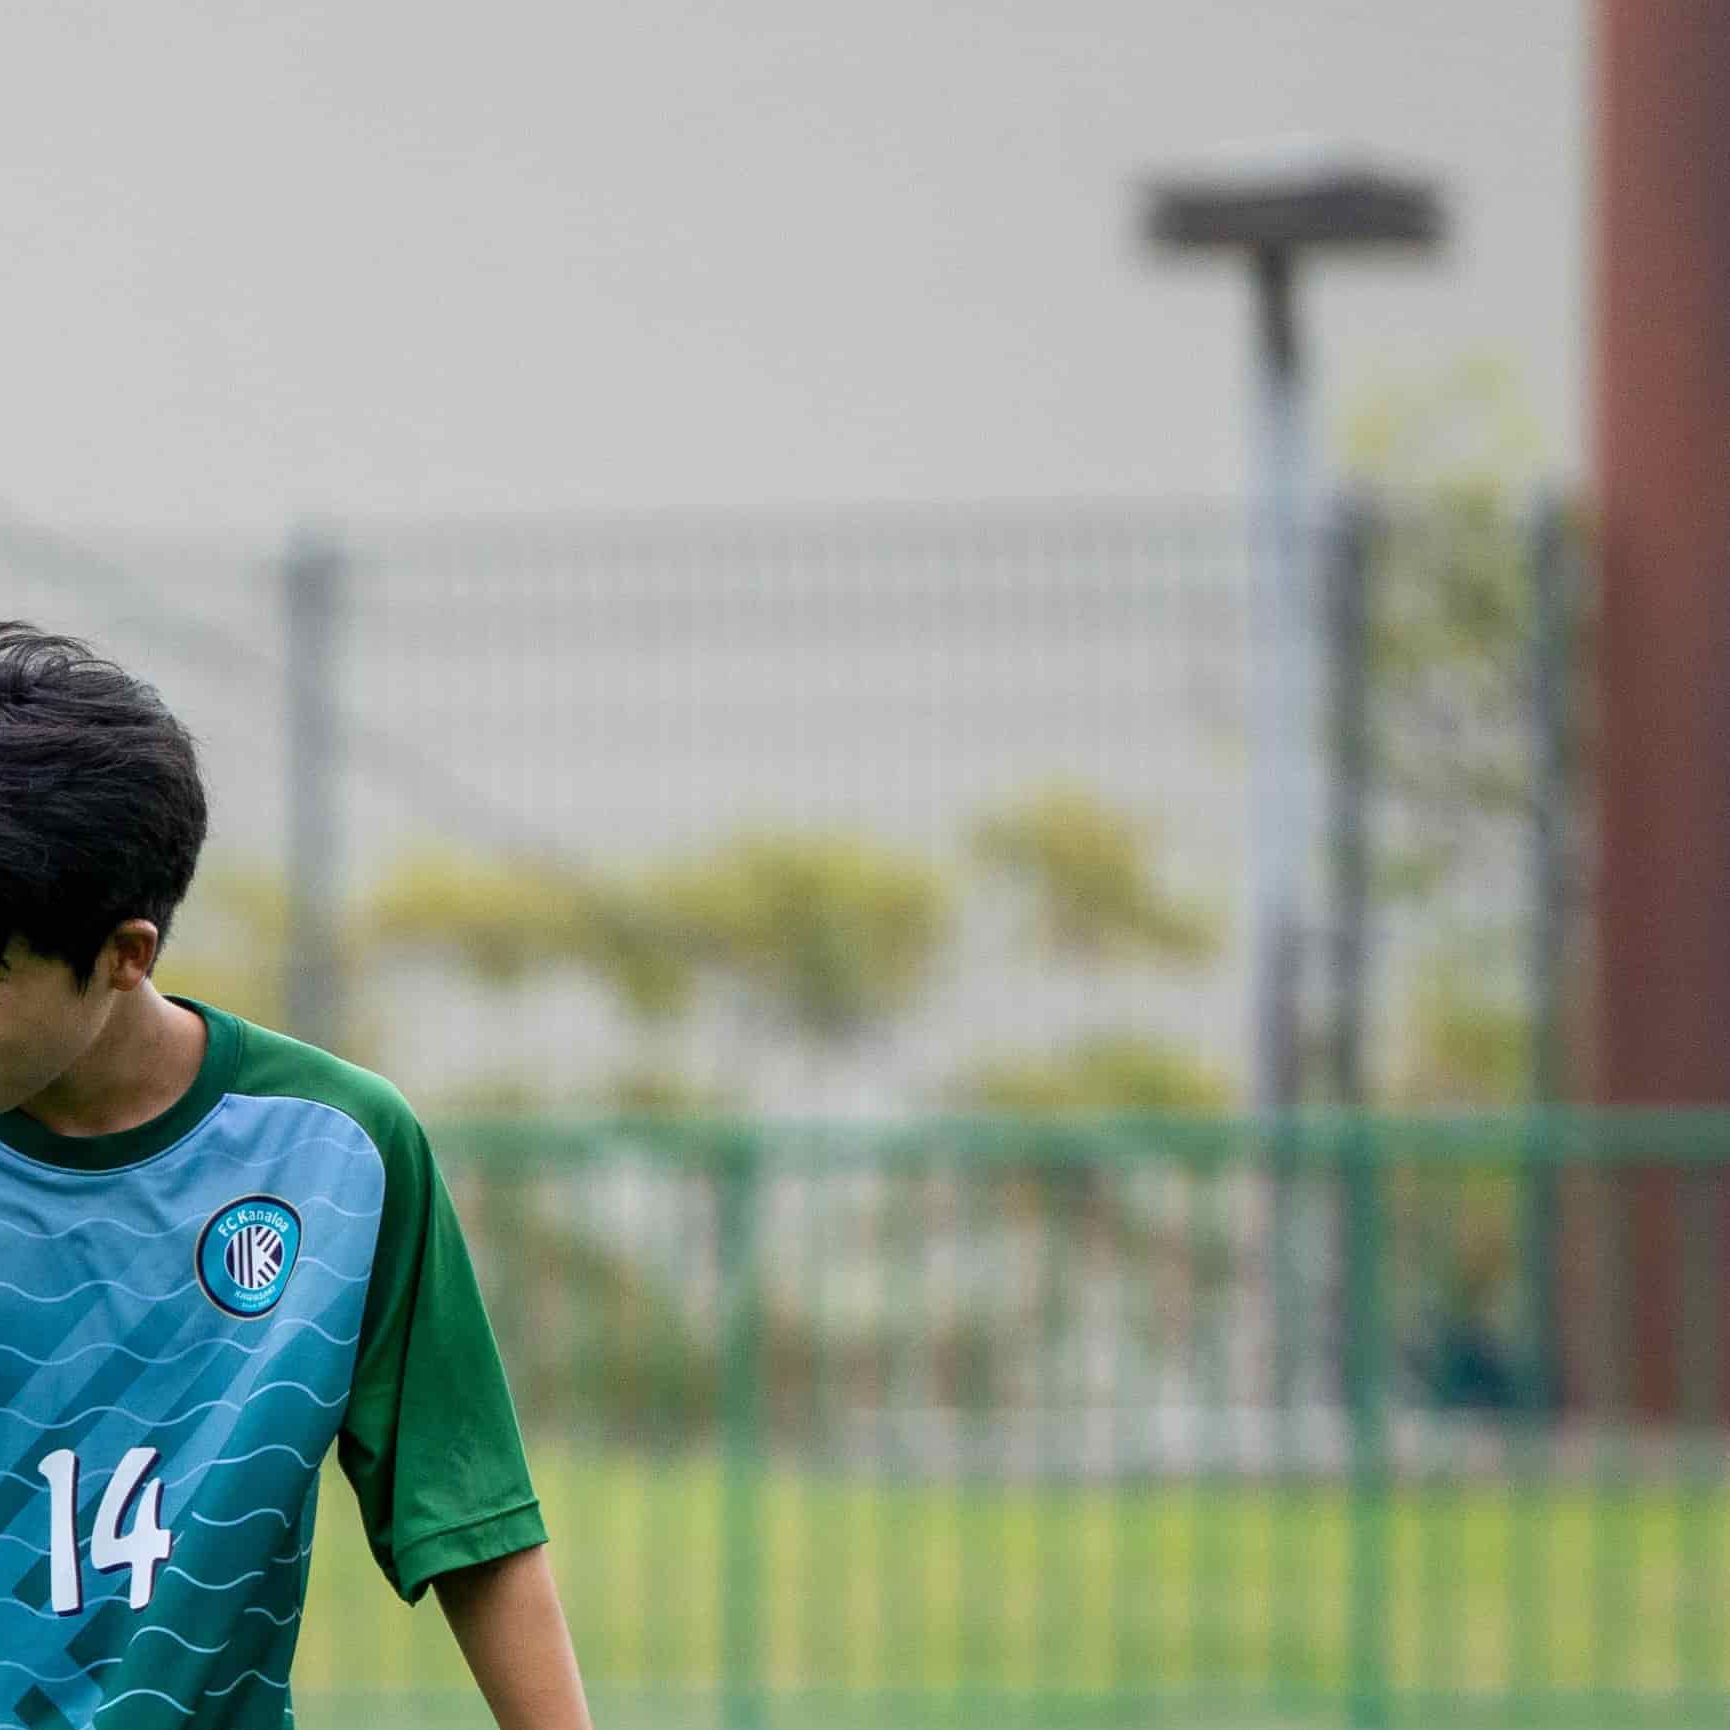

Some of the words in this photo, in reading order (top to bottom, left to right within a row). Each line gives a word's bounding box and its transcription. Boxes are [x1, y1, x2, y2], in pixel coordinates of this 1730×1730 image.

[218, 1216, 238, 1237] FC
[237, 1209, 289, 1232] Kanaloa
[38, 1447, 172, 1616] 14
